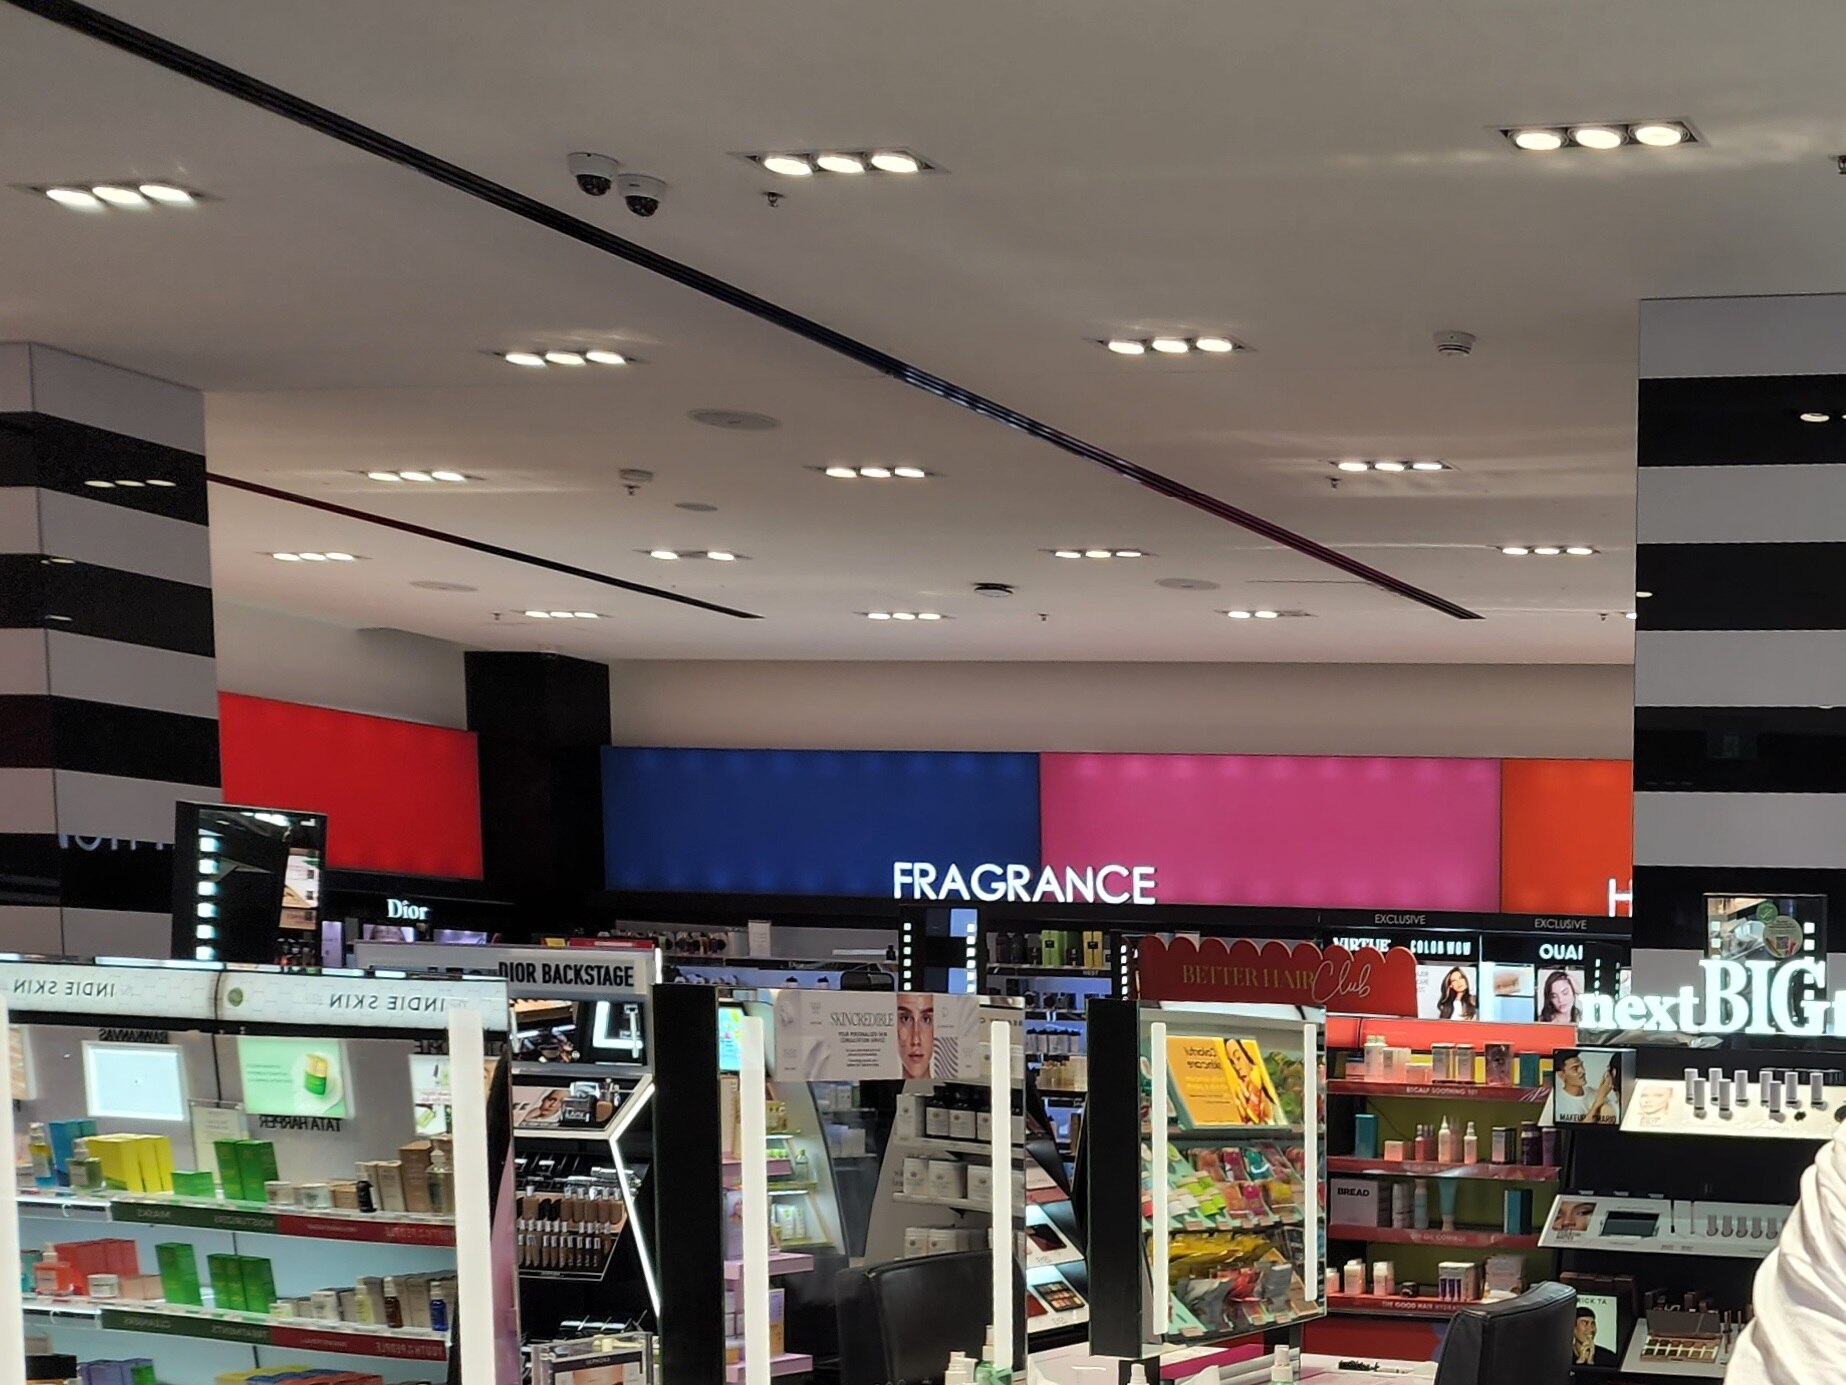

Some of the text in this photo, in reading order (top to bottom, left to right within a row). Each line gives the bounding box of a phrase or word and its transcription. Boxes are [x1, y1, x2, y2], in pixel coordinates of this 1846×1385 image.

[893, 861, 1157, 905] FRAGRANCE
[1608, 878, 1632, 918] H
[387, 899, 429, 920] Dior
[1374, 914, 1427, 925] EXCLUSIVE
[1534, 918, 1587, 930] EXCLUSIVE
[1333, 937, 1392, 953] VIRTUE
[1410, 939, 1472, 956] COLOR WOW
[1539, 943, 1584, 961] OUAI
[498, 961, 634, 988] DIOR BACKSTAGE
[1183, 960, 1371, 1004] BETTER HAIR Club
[830, 1011, 895, 1027] SKINCREDIBLE
[1560, 1113, 1587, 1123] MAKEUP
[1336, 1187, 1370, 1197] BREAD
[1394, 1301, 1416, 1309] GOOD
[1575, 1296, 1595, 1305] RICK
